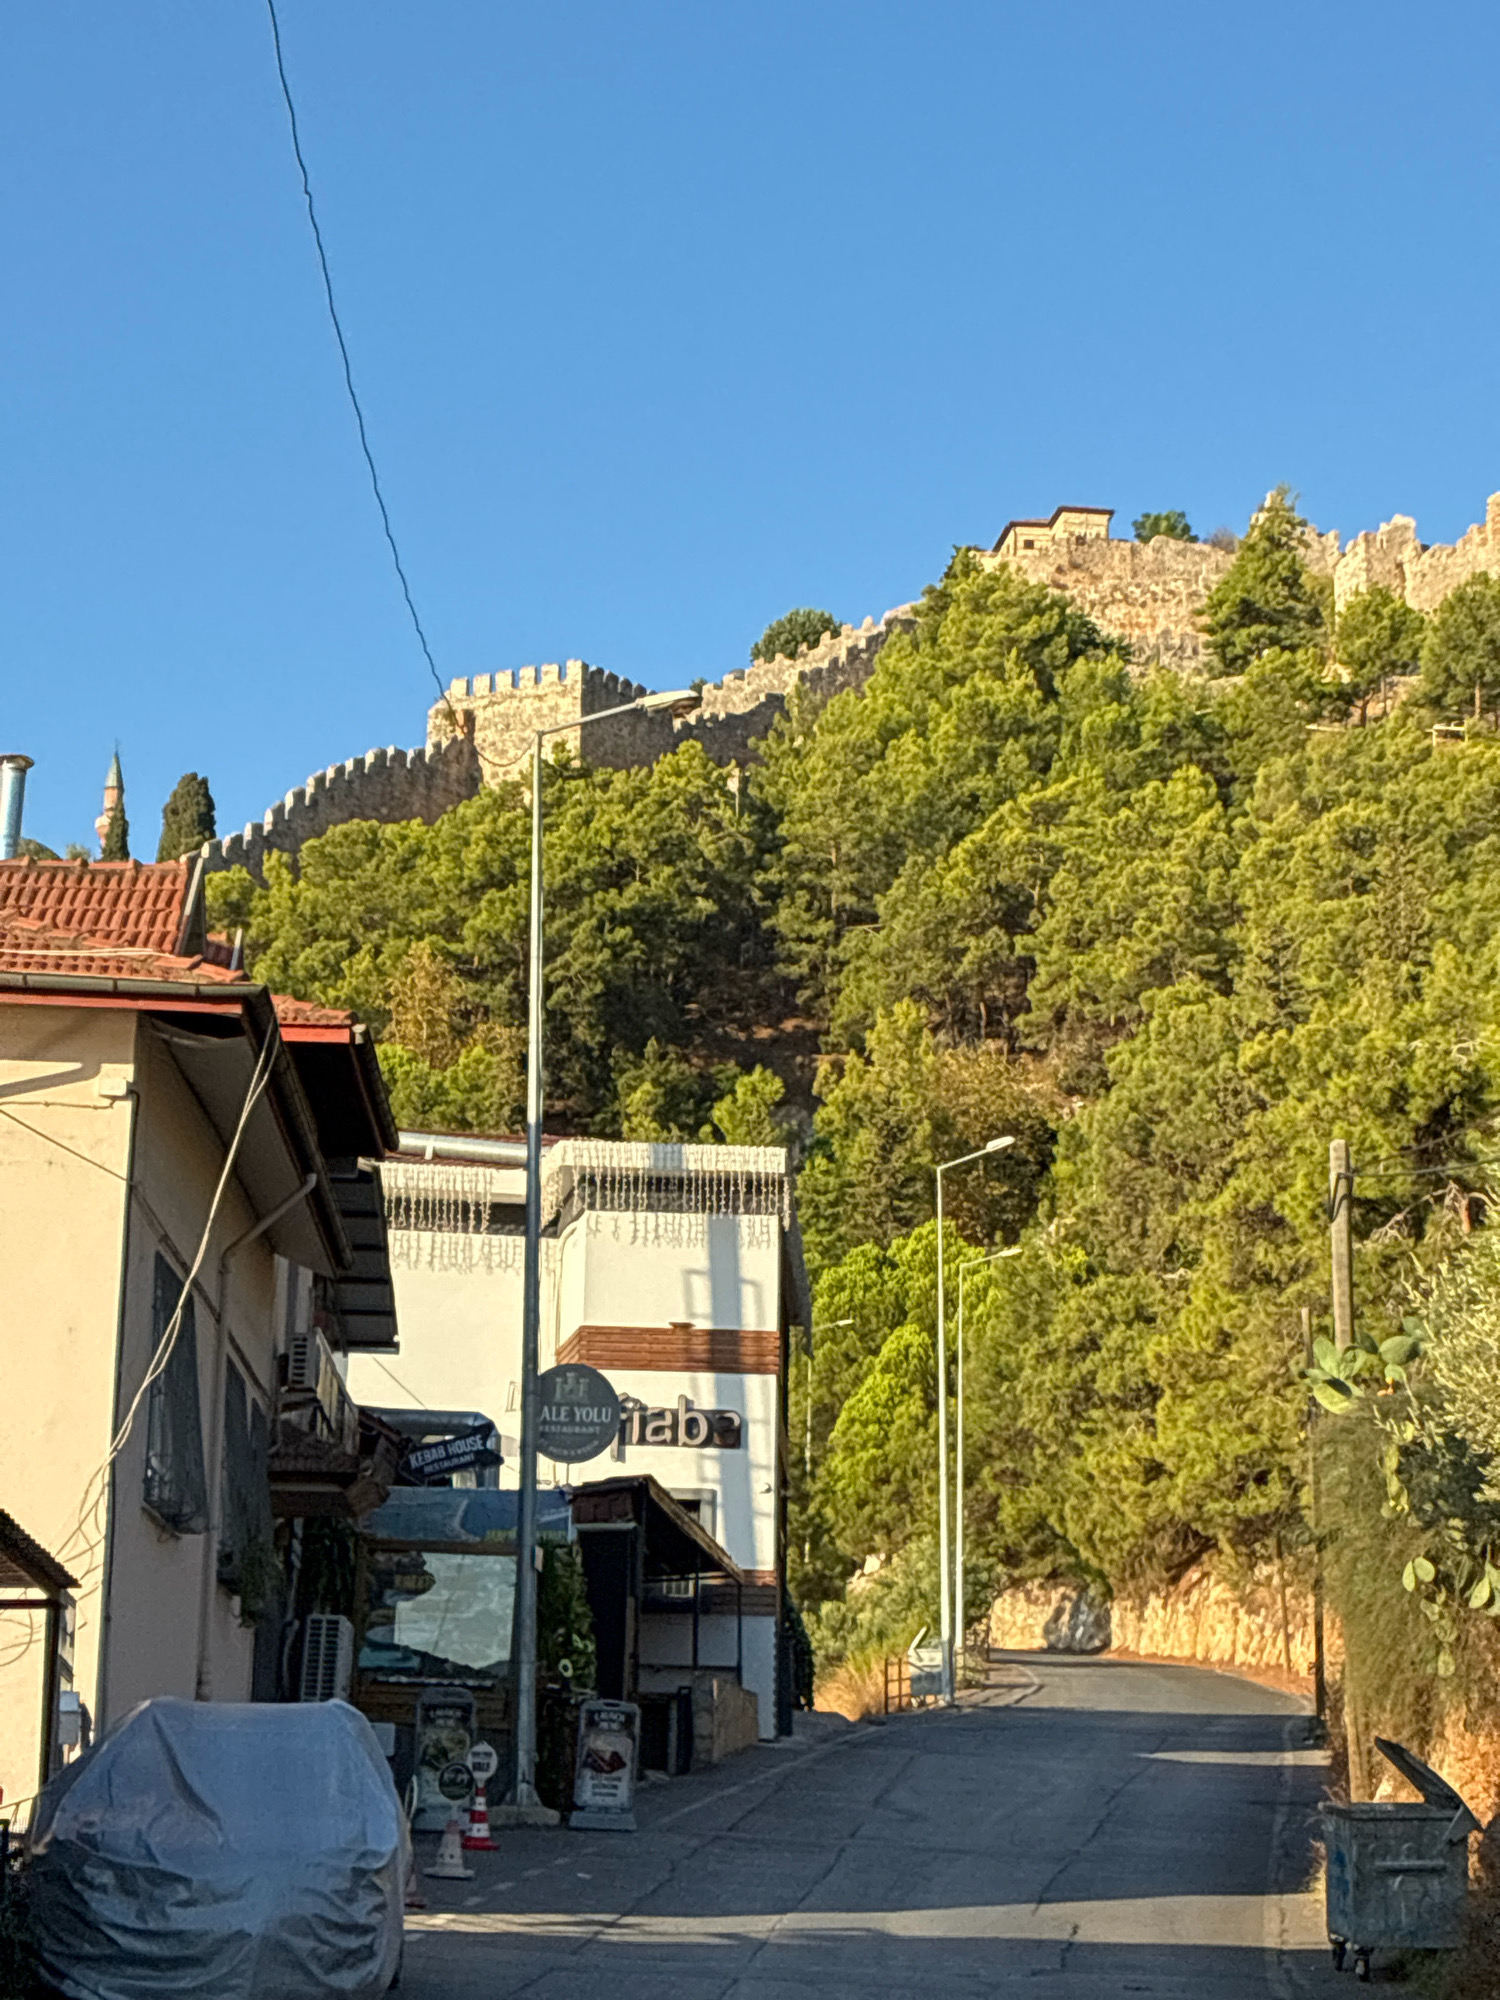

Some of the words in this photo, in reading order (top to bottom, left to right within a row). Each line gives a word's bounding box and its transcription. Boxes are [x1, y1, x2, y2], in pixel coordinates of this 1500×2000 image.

[540, 1405, 570, 1422] ALE
[573, 1406, 612, 1423] YOLU
[408, 1445, 446, 1469] KEBAB
[447, 1435, 485, 1455] HOUSE
[423, 1454, 475, 1475] RESTAURANT
